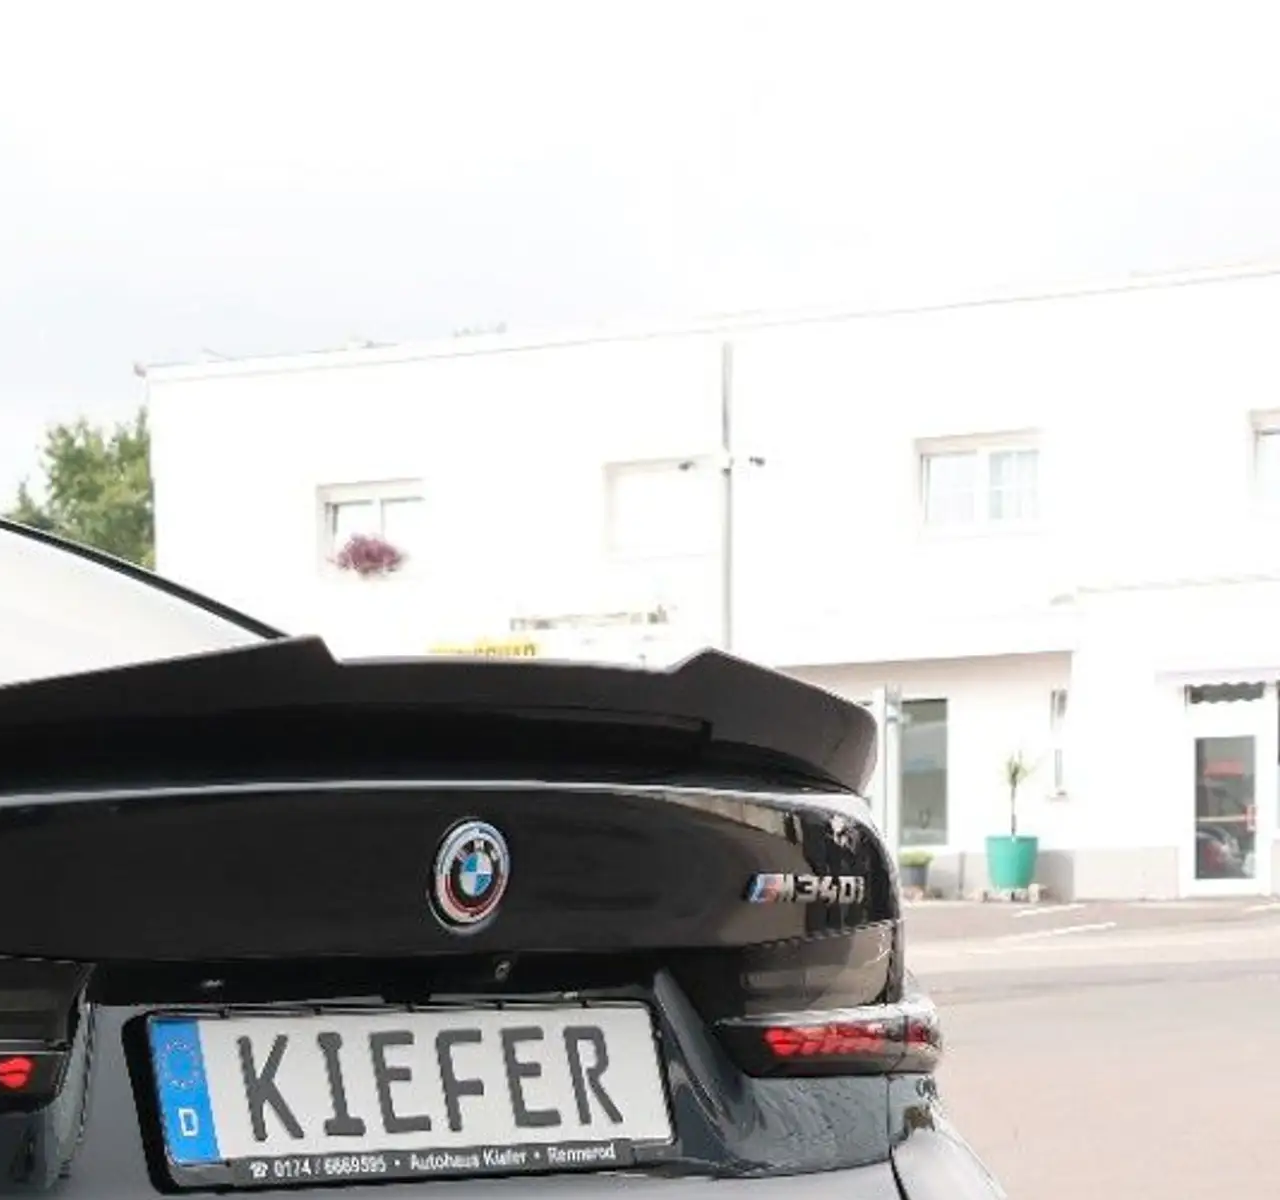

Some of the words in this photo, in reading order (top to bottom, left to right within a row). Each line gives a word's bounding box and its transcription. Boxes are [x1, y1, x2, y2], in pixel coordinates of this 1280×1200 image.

[237, 1025, 624, 1141] KIEFER
[178, 1107, 199, 1137] D
[411, 1153, 480, 1170] Autohaus
[482, 1147, 527, 1167] Kiefer
[547, 1142, 616, 1164] Rennerod
